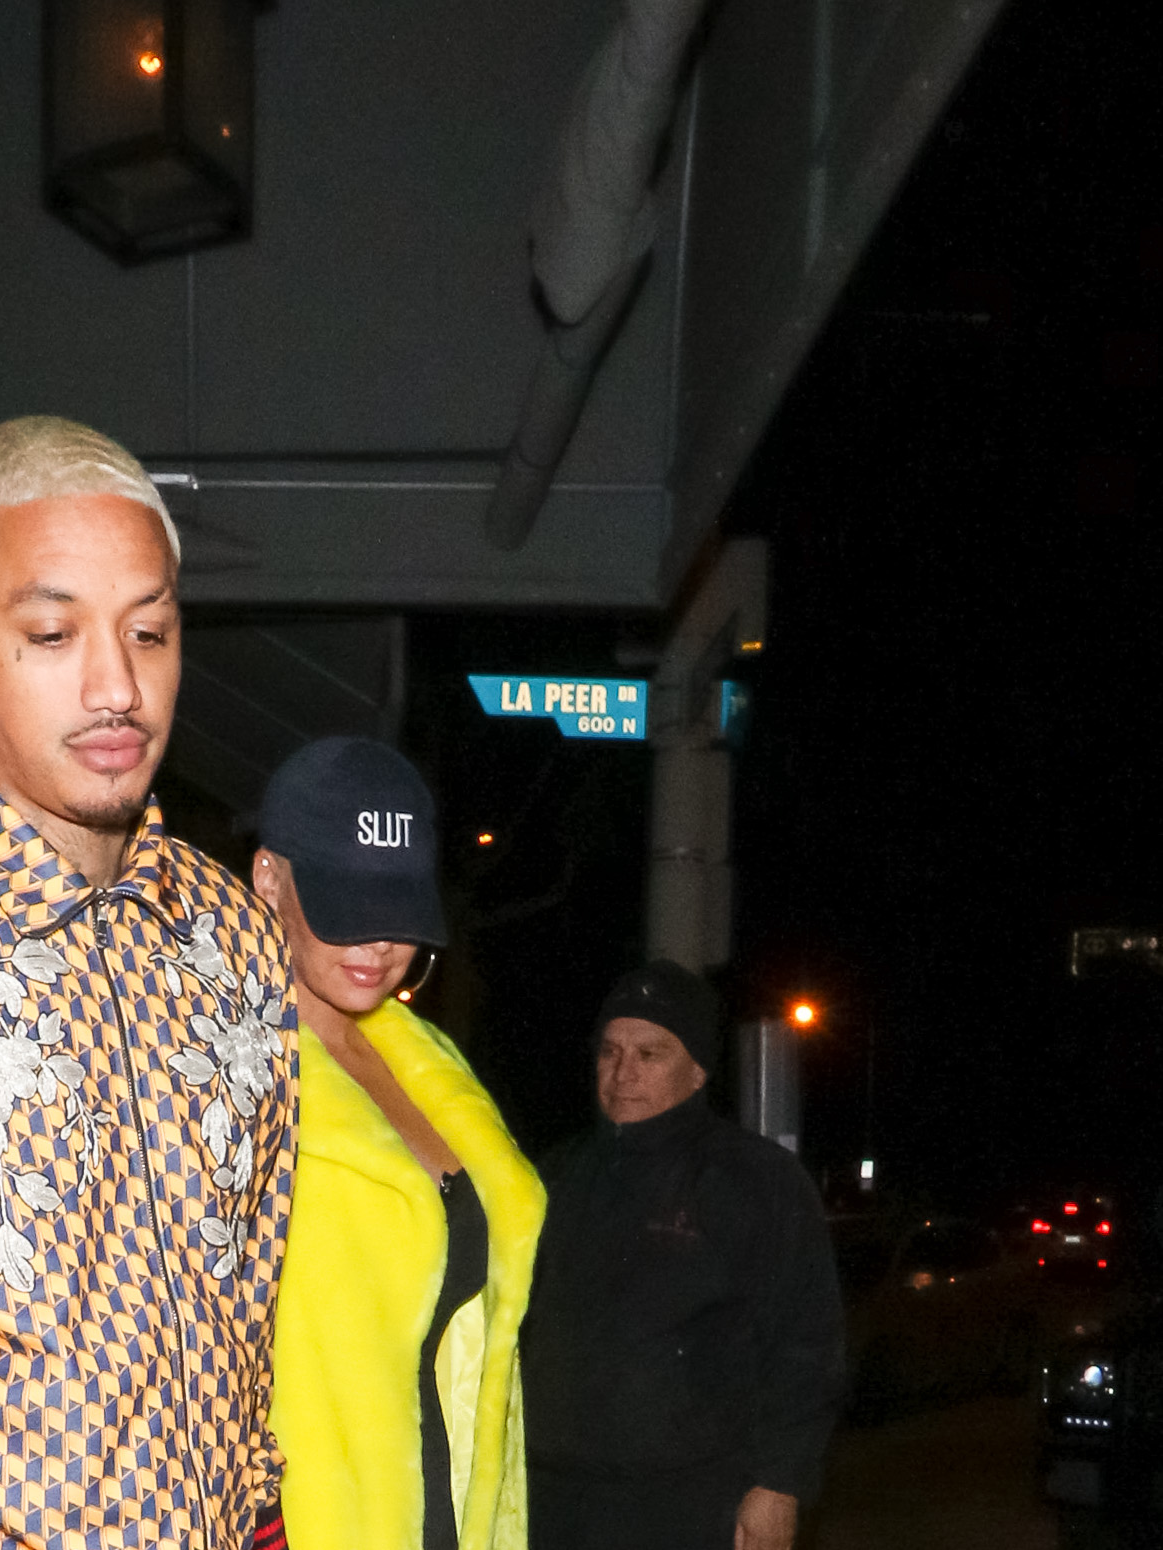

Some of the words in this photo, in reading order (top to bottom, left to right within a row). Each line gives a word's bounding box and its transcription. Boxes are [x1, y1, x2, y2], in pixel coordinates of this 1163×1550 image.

[501, 681, 532, 711] LA
[544, 682, 607, 714] PEER
[618, 685, 637, 702] DR
[578, 716, 615, 733] 600
[622, 718, 636, 734] N
[357, 810, 413, 848] SLUT
